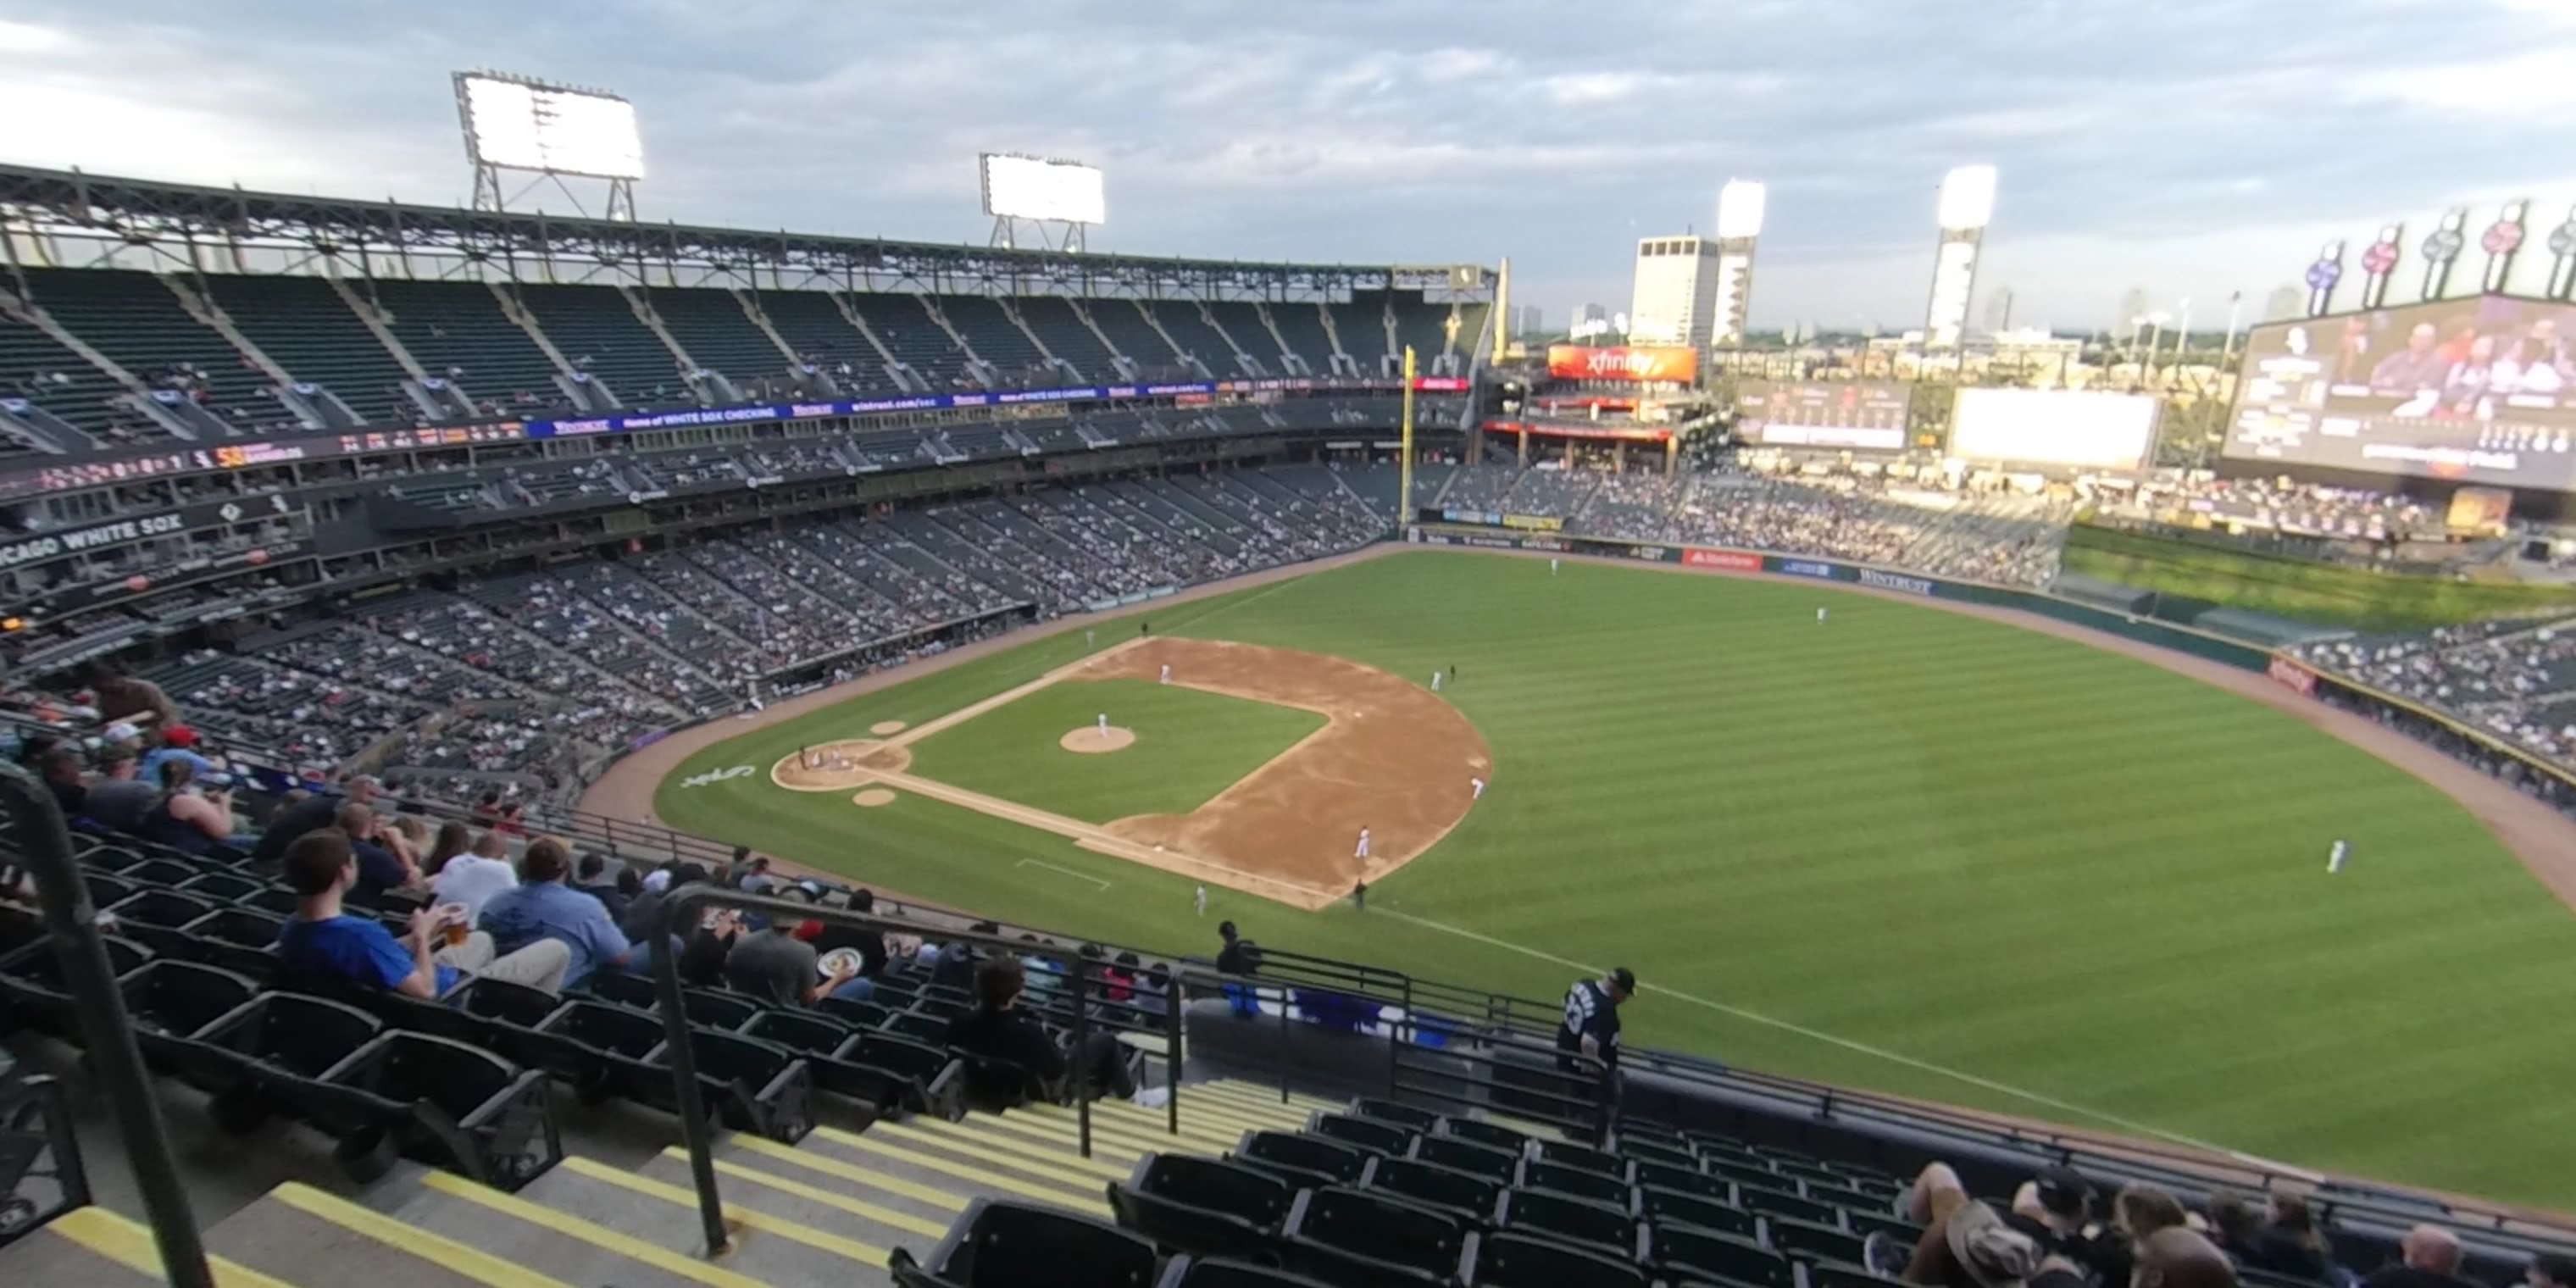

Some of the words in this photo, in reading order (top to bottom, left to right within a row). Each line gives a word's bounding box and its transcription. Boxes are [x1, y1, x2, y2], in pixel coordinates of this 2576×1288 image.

[1586, 350, 1656, 376] xfinity
[663, 412, 699, 425] WHITE
[702, 410, 724, 422] SOX
[724, 407, 775, 420] CHECKING
[61, 520, 139, 550] WHITE
[139, 514, 184, 536] SOX
[1859, 567, 1933, 595] WINTRUST
